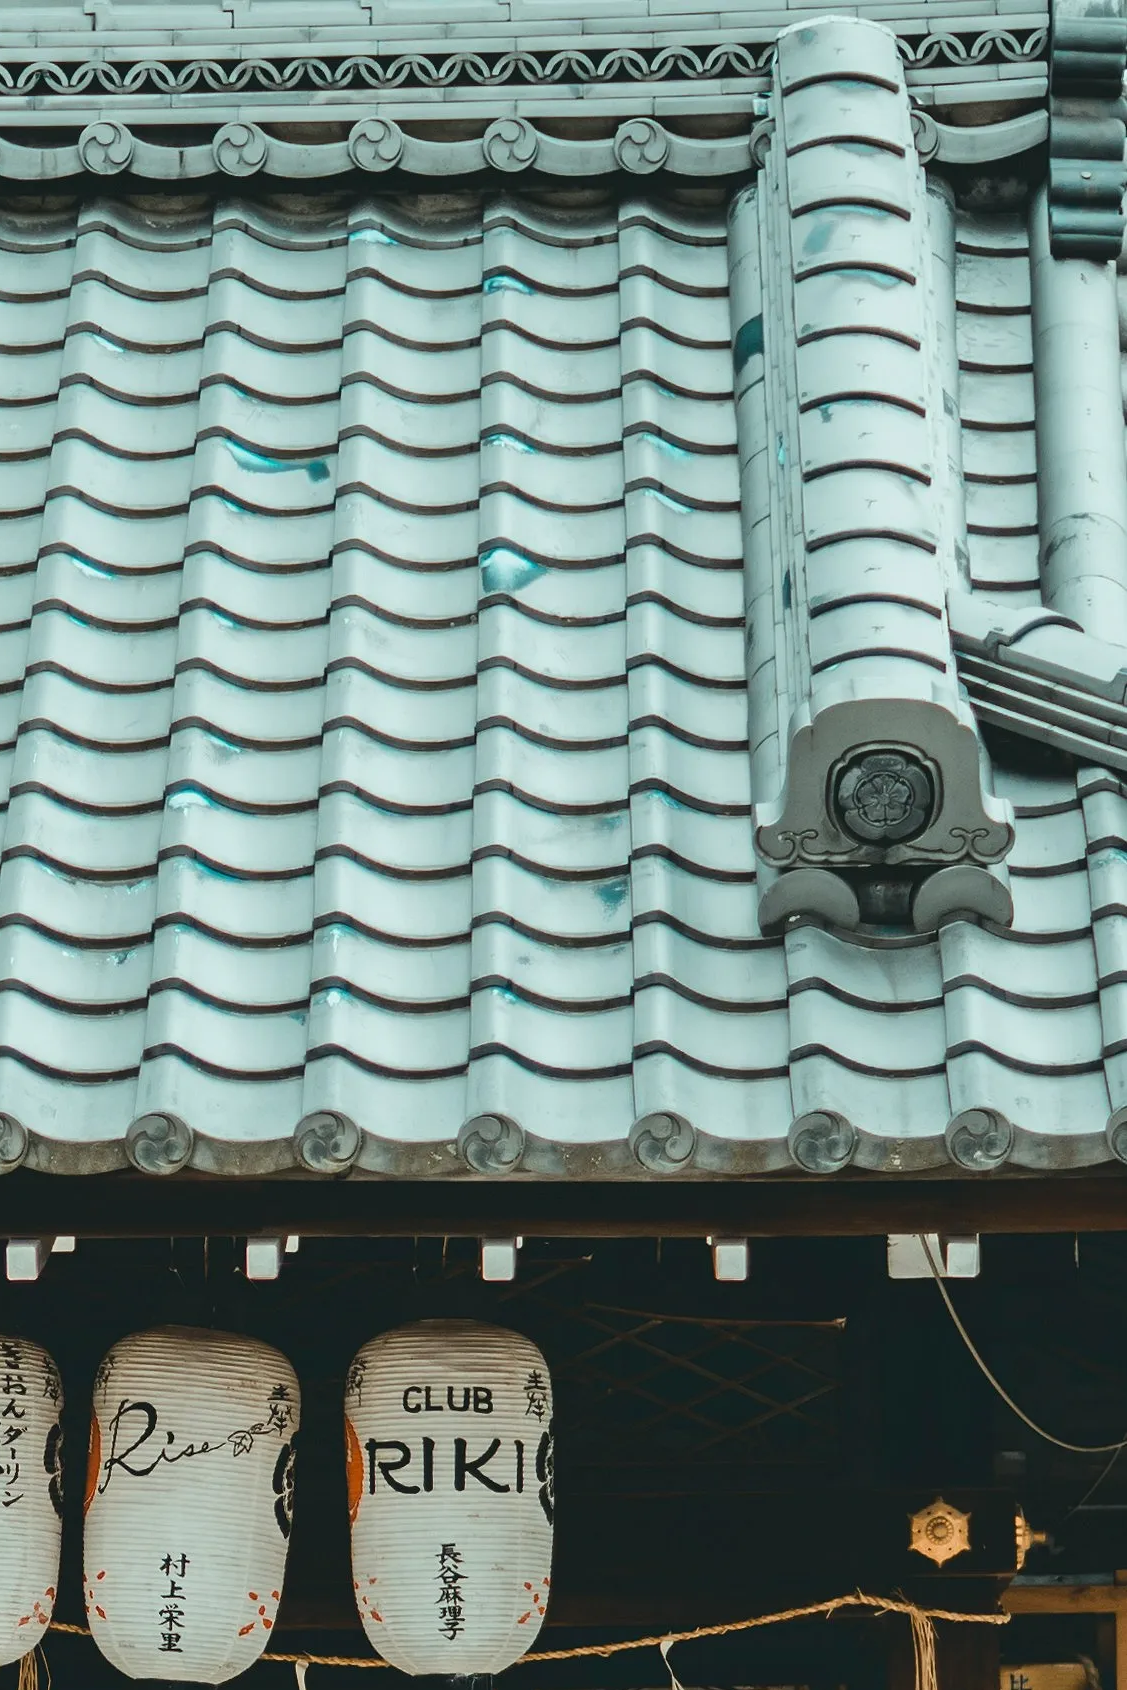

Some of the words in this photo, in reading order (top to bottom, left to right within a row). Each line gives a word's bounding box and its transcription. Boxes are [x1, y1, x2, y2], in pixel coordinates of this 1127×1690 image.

[97, 1399, 227, 1496] Rise
[402, 1385, 494, 1414] CLUB
[364, 1436, 525, 1496] RIKI
[157, 1552, 190, 1653] 村上栄里
[435, 1542, 468, 1641] 長谷麻理子
